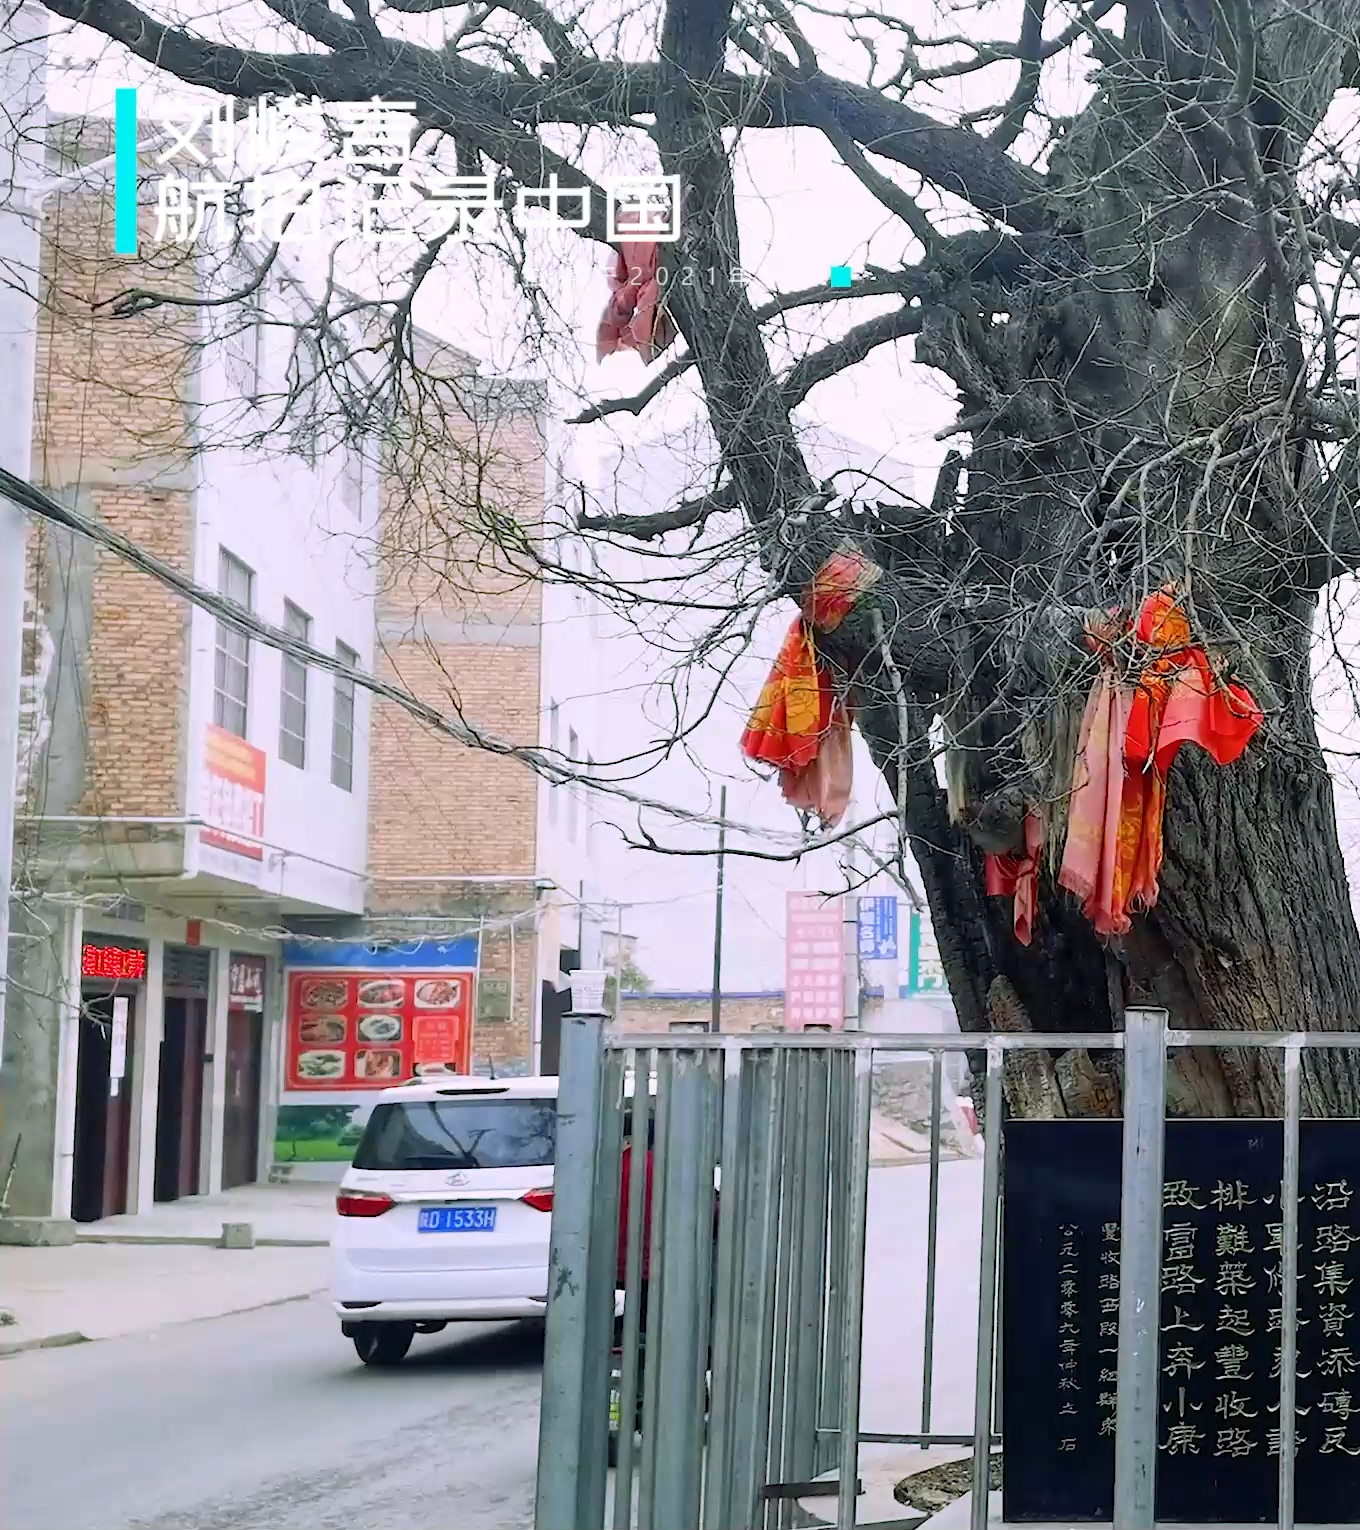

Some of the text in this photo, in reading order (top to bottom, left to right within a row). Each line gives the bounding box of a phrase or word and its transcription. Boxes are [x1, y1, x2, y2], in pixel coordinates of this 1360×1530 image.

[1158, 1179, 1208, 1456] 致富路上奔小康
